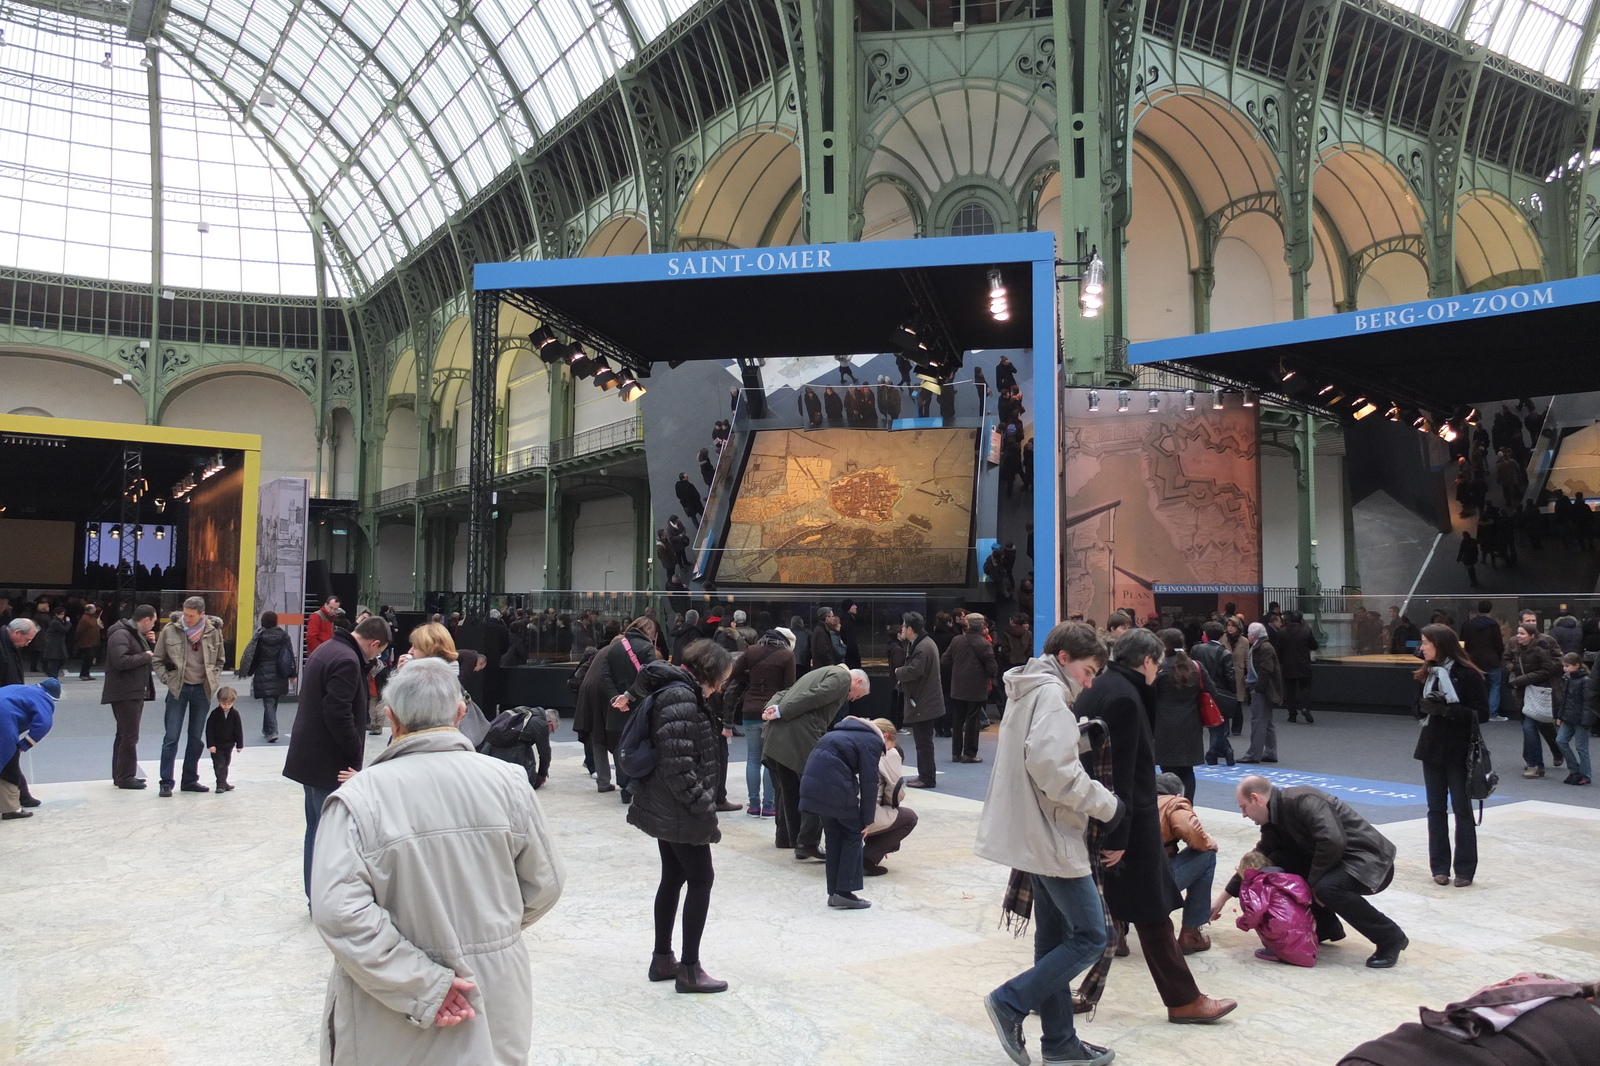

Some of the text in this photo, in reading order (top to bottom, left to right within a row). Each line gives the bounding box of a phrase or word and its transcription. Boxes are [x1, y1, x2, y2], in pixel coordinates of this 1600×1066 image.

[668, 249, 832, 276] SAINT-OMER
[1355, 287, 1555, 331] BERG-OP-ZOOM
[1220, 584, 1259, 592] DÉFENSIVE
